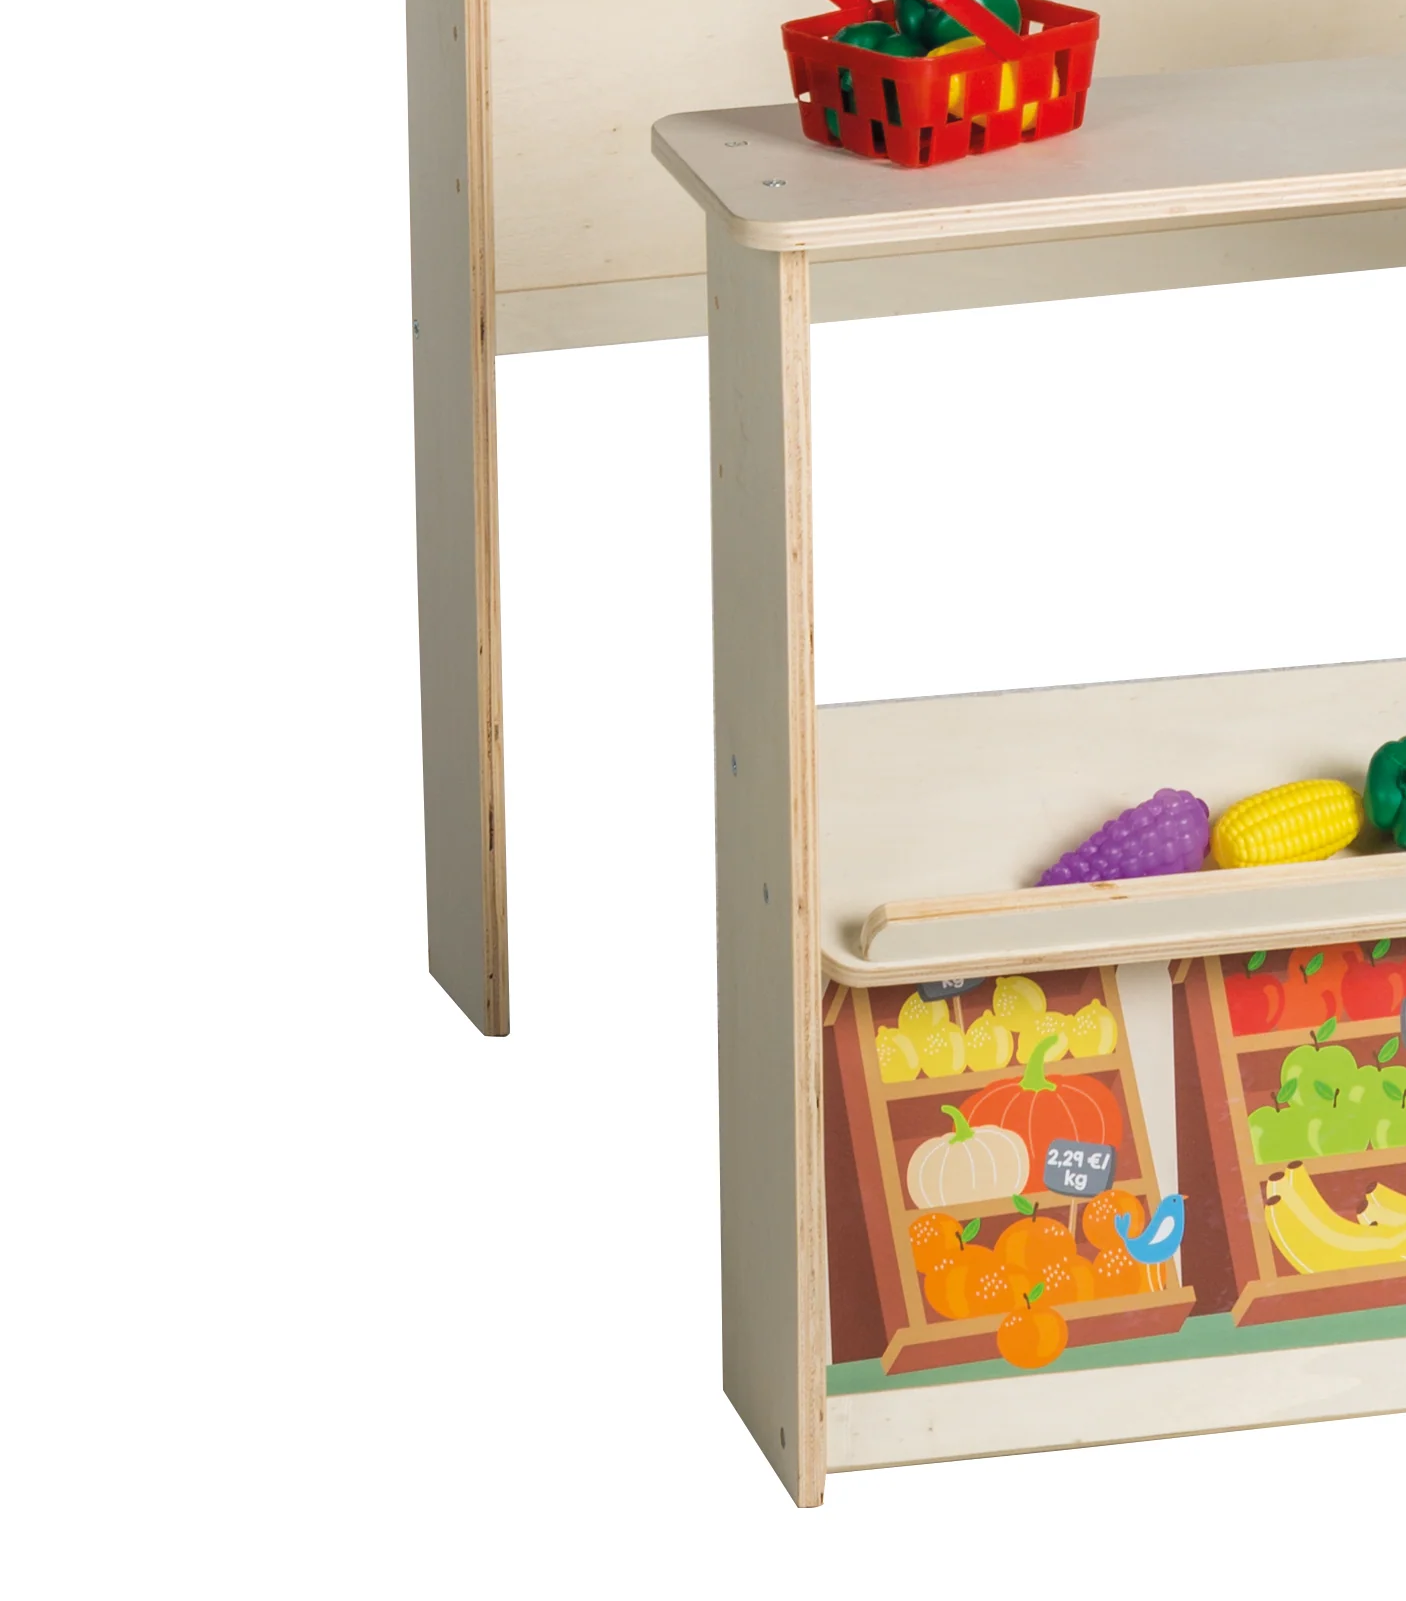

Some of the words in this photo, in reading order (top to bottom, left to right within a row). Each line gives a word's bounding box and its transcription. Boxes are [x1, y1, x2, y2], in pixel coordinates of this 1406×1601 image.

[1047, 1148, 1084, 1168] 2,29
[1087, 1152, 1111, 1170] €/
[1064, 1169, 1087, 1191] kg
